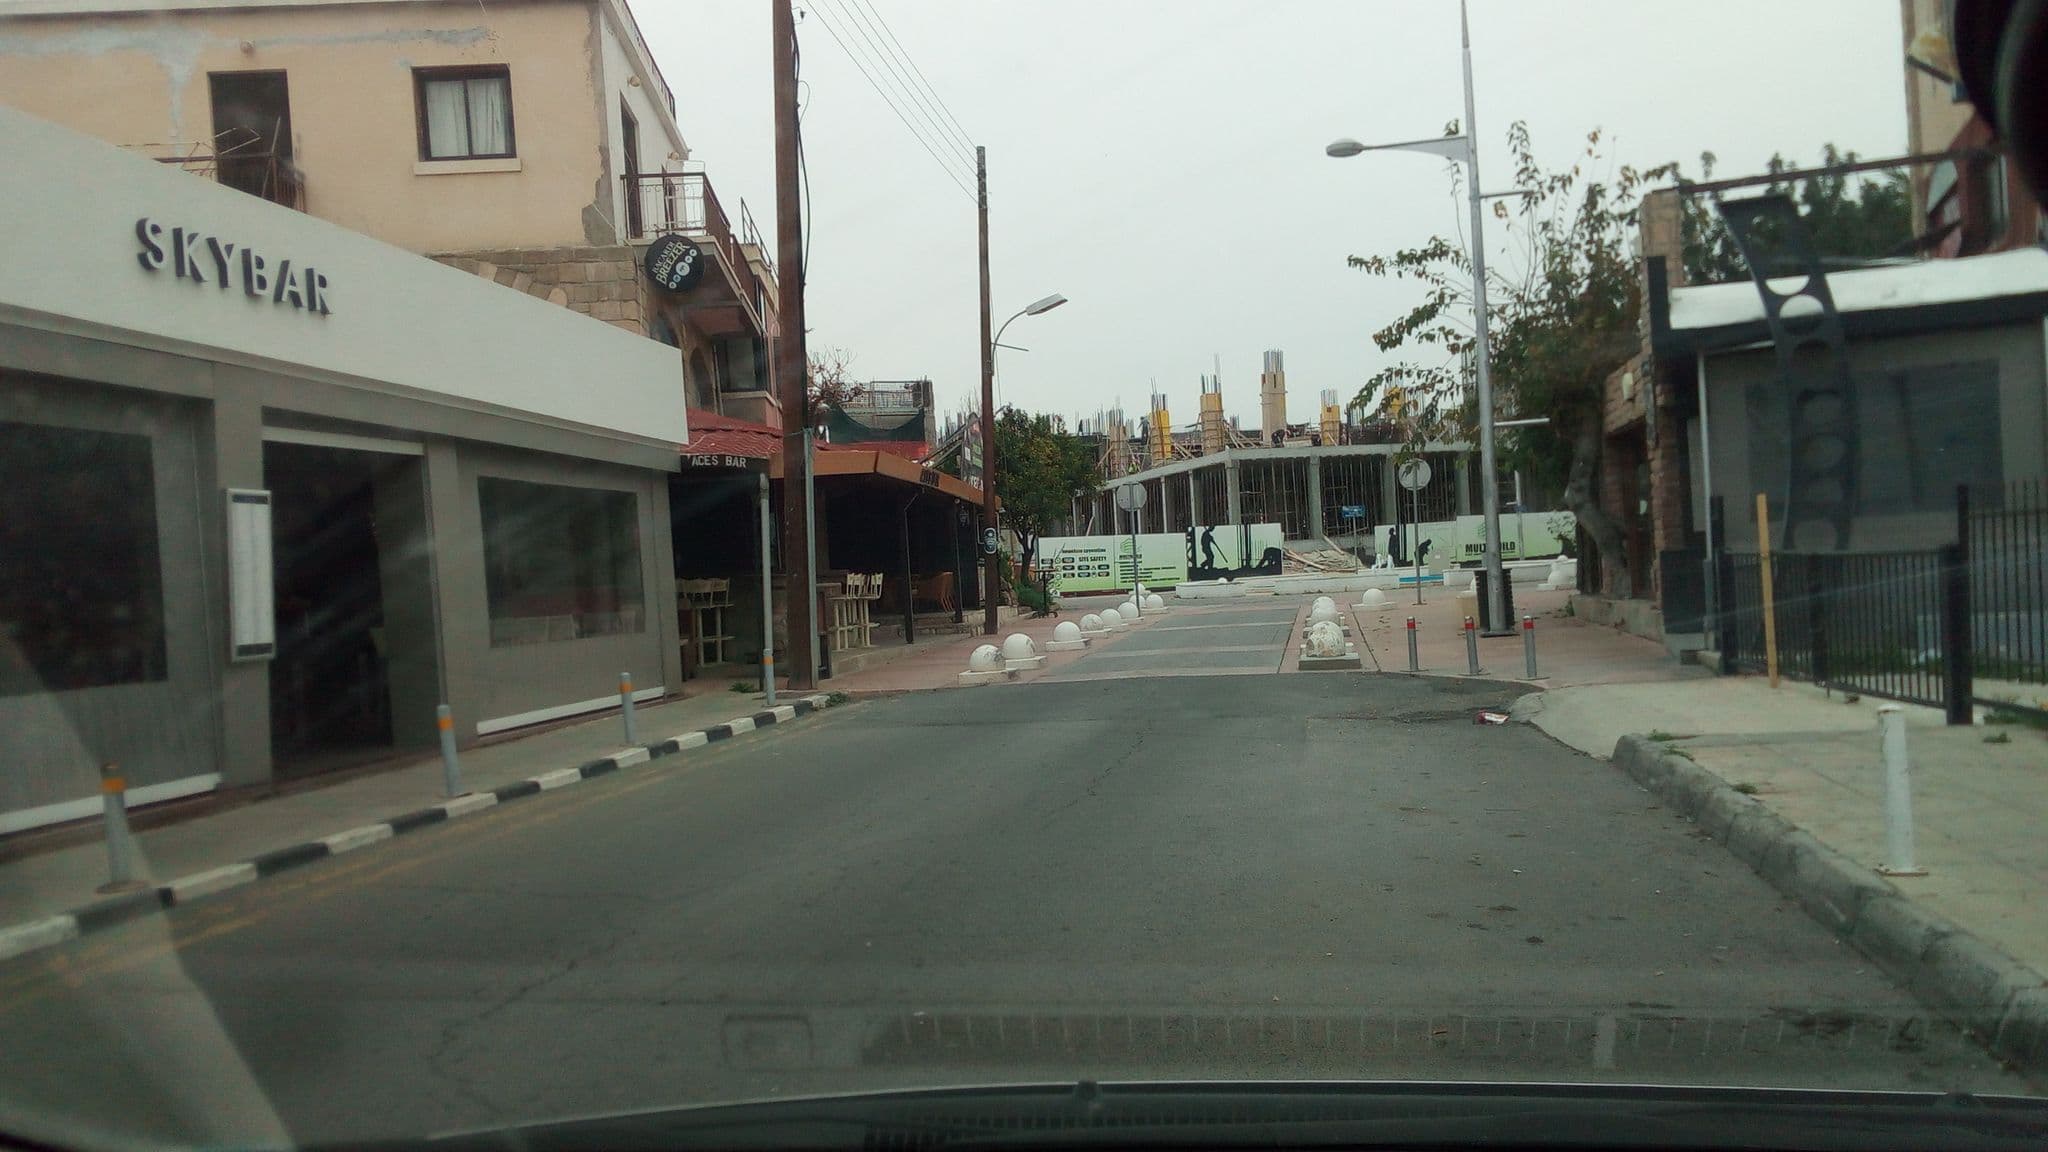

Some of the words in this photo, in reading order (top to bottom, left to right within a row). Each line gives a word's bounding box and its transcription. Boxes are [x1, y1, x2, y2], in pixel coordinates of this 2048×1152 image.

[135, 217, 334, 316] SKYBAR
[655, 242, 690, 286] BREEZER
[691, 455, 719, 467] ACES
[725, 455, 747, 468] BAR
